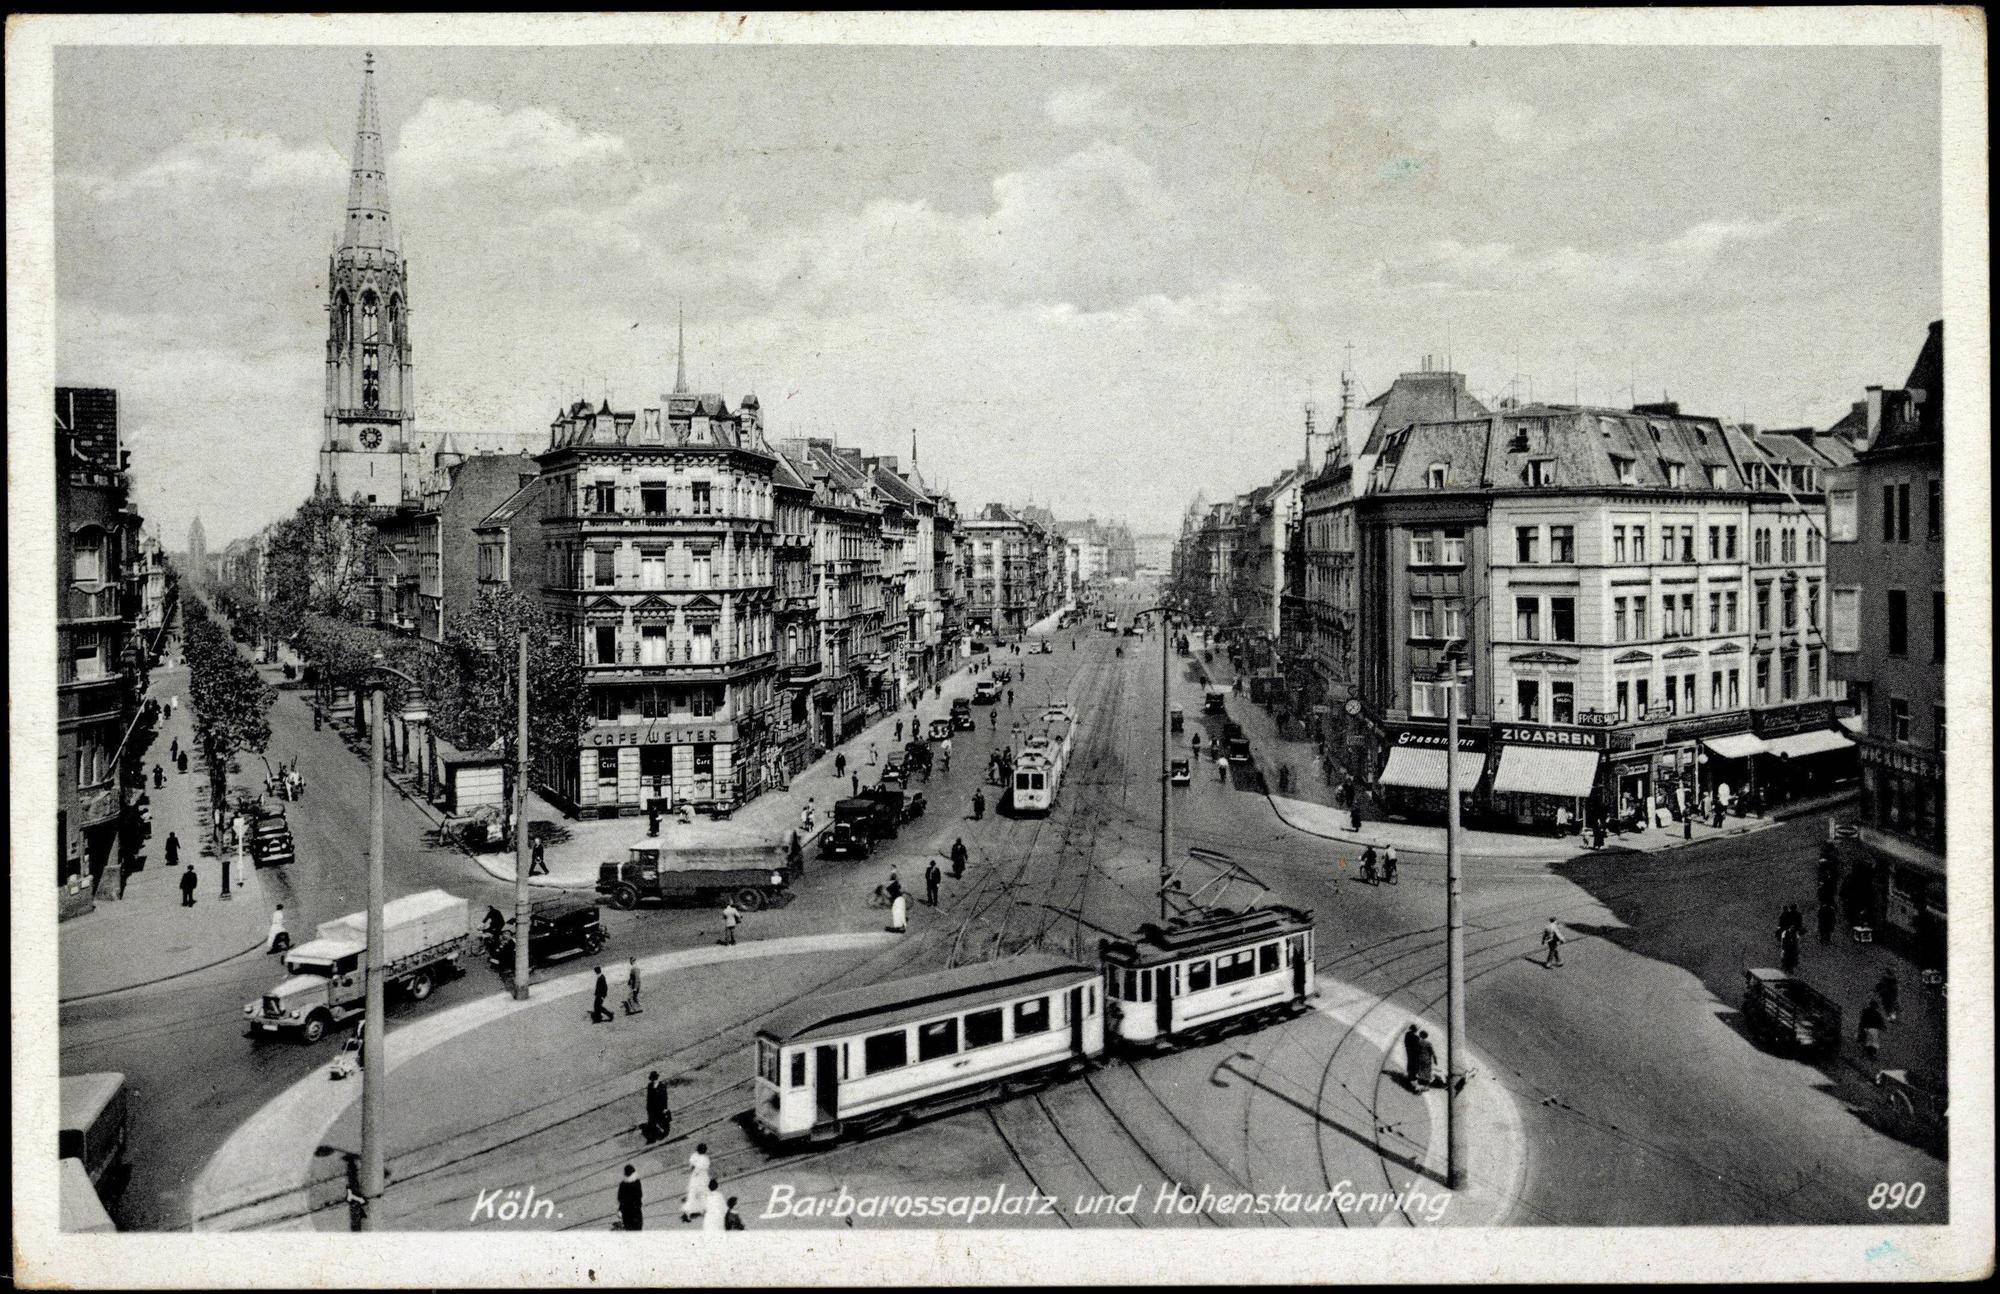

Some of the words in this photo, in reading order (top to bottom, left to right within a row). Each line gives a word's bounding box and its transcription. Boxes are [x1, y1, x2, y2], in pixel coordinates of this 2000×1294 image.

[594, 732, 637, 746] CAFE
[649, 730, 717, 744] WELTER
[1398, 732, 1475, 747] Grassmnn
[1501, 728, 1596, 746] ZIGARREN
